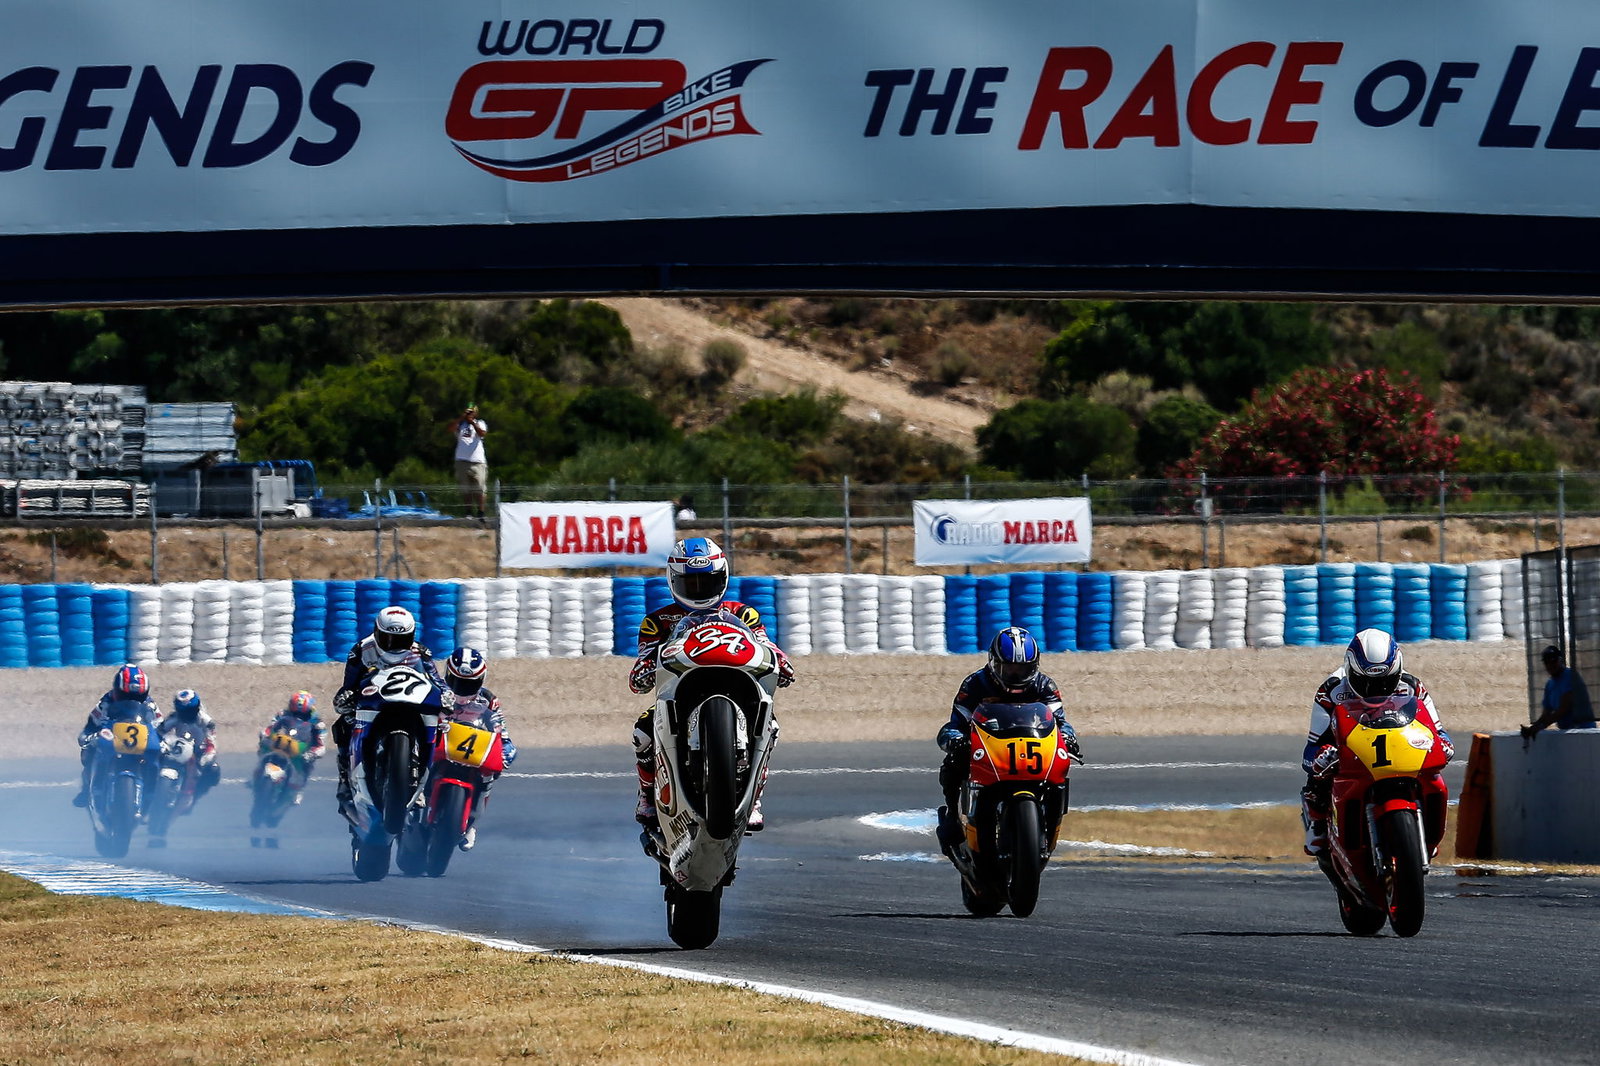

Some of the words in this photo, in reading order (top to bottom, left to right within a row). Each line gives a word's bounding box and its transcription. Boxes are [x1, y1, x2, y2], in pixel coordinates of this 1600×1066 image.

[477, 19, 665, 55] WORLD
[445, 59, 686, 140] GP
[663, 69, 732, 114] BIKE
[864, 66, 1008, 138] THE
[1017, 41, 1344, 150] RACE
[1354, 59, 1480, 128] OF
[0, 60, 375, 171] GENDS
[566, 102, 736, 178] LEGENDS
[529, 515, 648, 554] MARCA
[1003, 519, 1079, 544] MARCA
[689, 557, 708, 567] Arai
[689, 628, 747, 657] 34
[380, 671, 427, 697] 27
[123, 726, 139, 748] 3
[456, 733, 478, 760] 4
[1371, 733, 1392, 769] 1
[1007, 741, 1043, 775] 15
